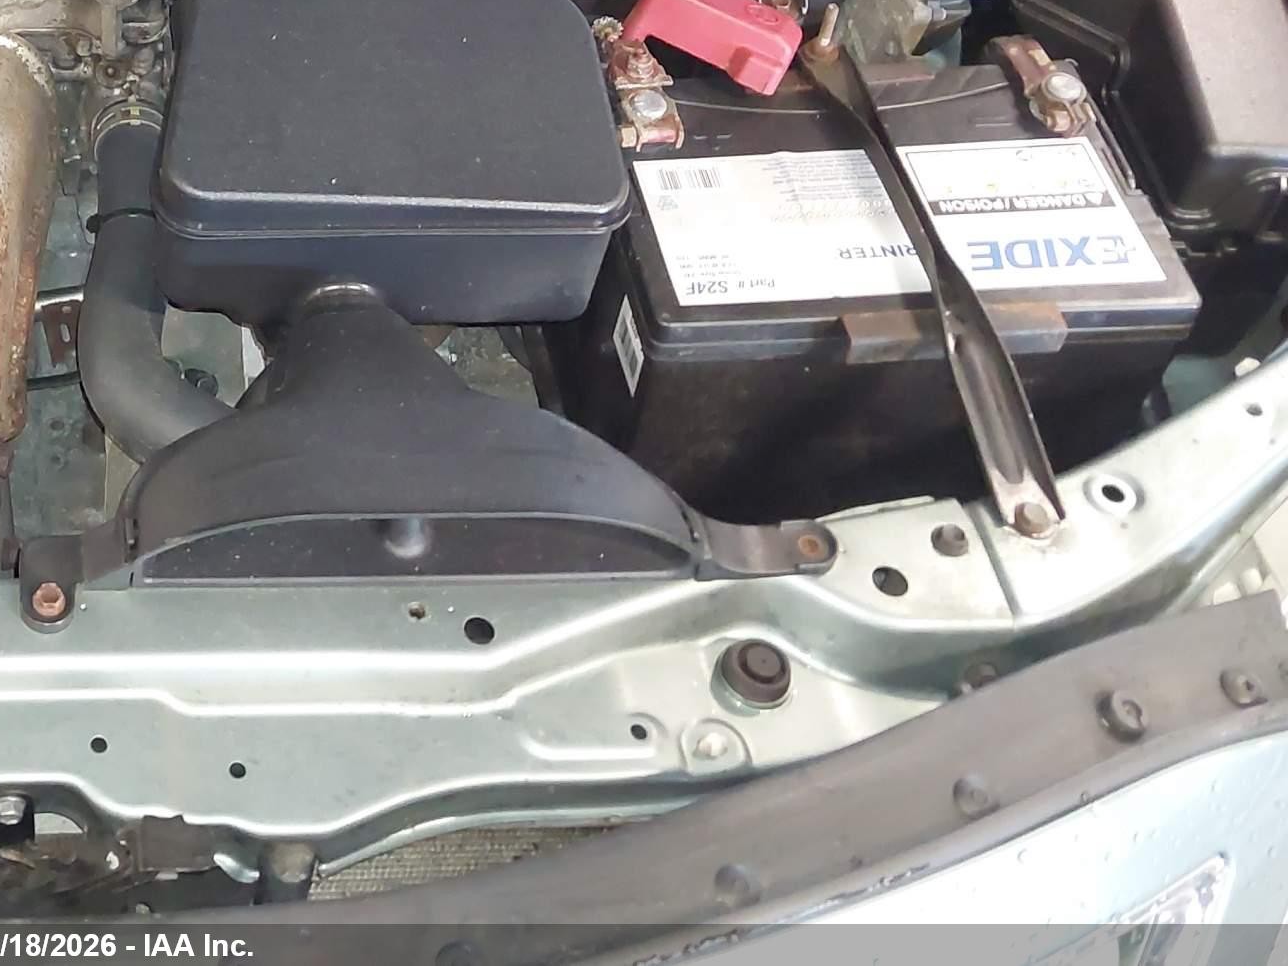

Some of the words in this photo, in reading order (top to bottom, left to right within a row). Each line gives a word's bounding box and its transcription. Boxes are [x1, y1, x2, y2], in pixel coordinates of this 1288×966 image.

[838, 244, 918, 260] RINTER
[966, 235, 1136, 271] EXIDE
[685, 280, 729, 296] S24F
